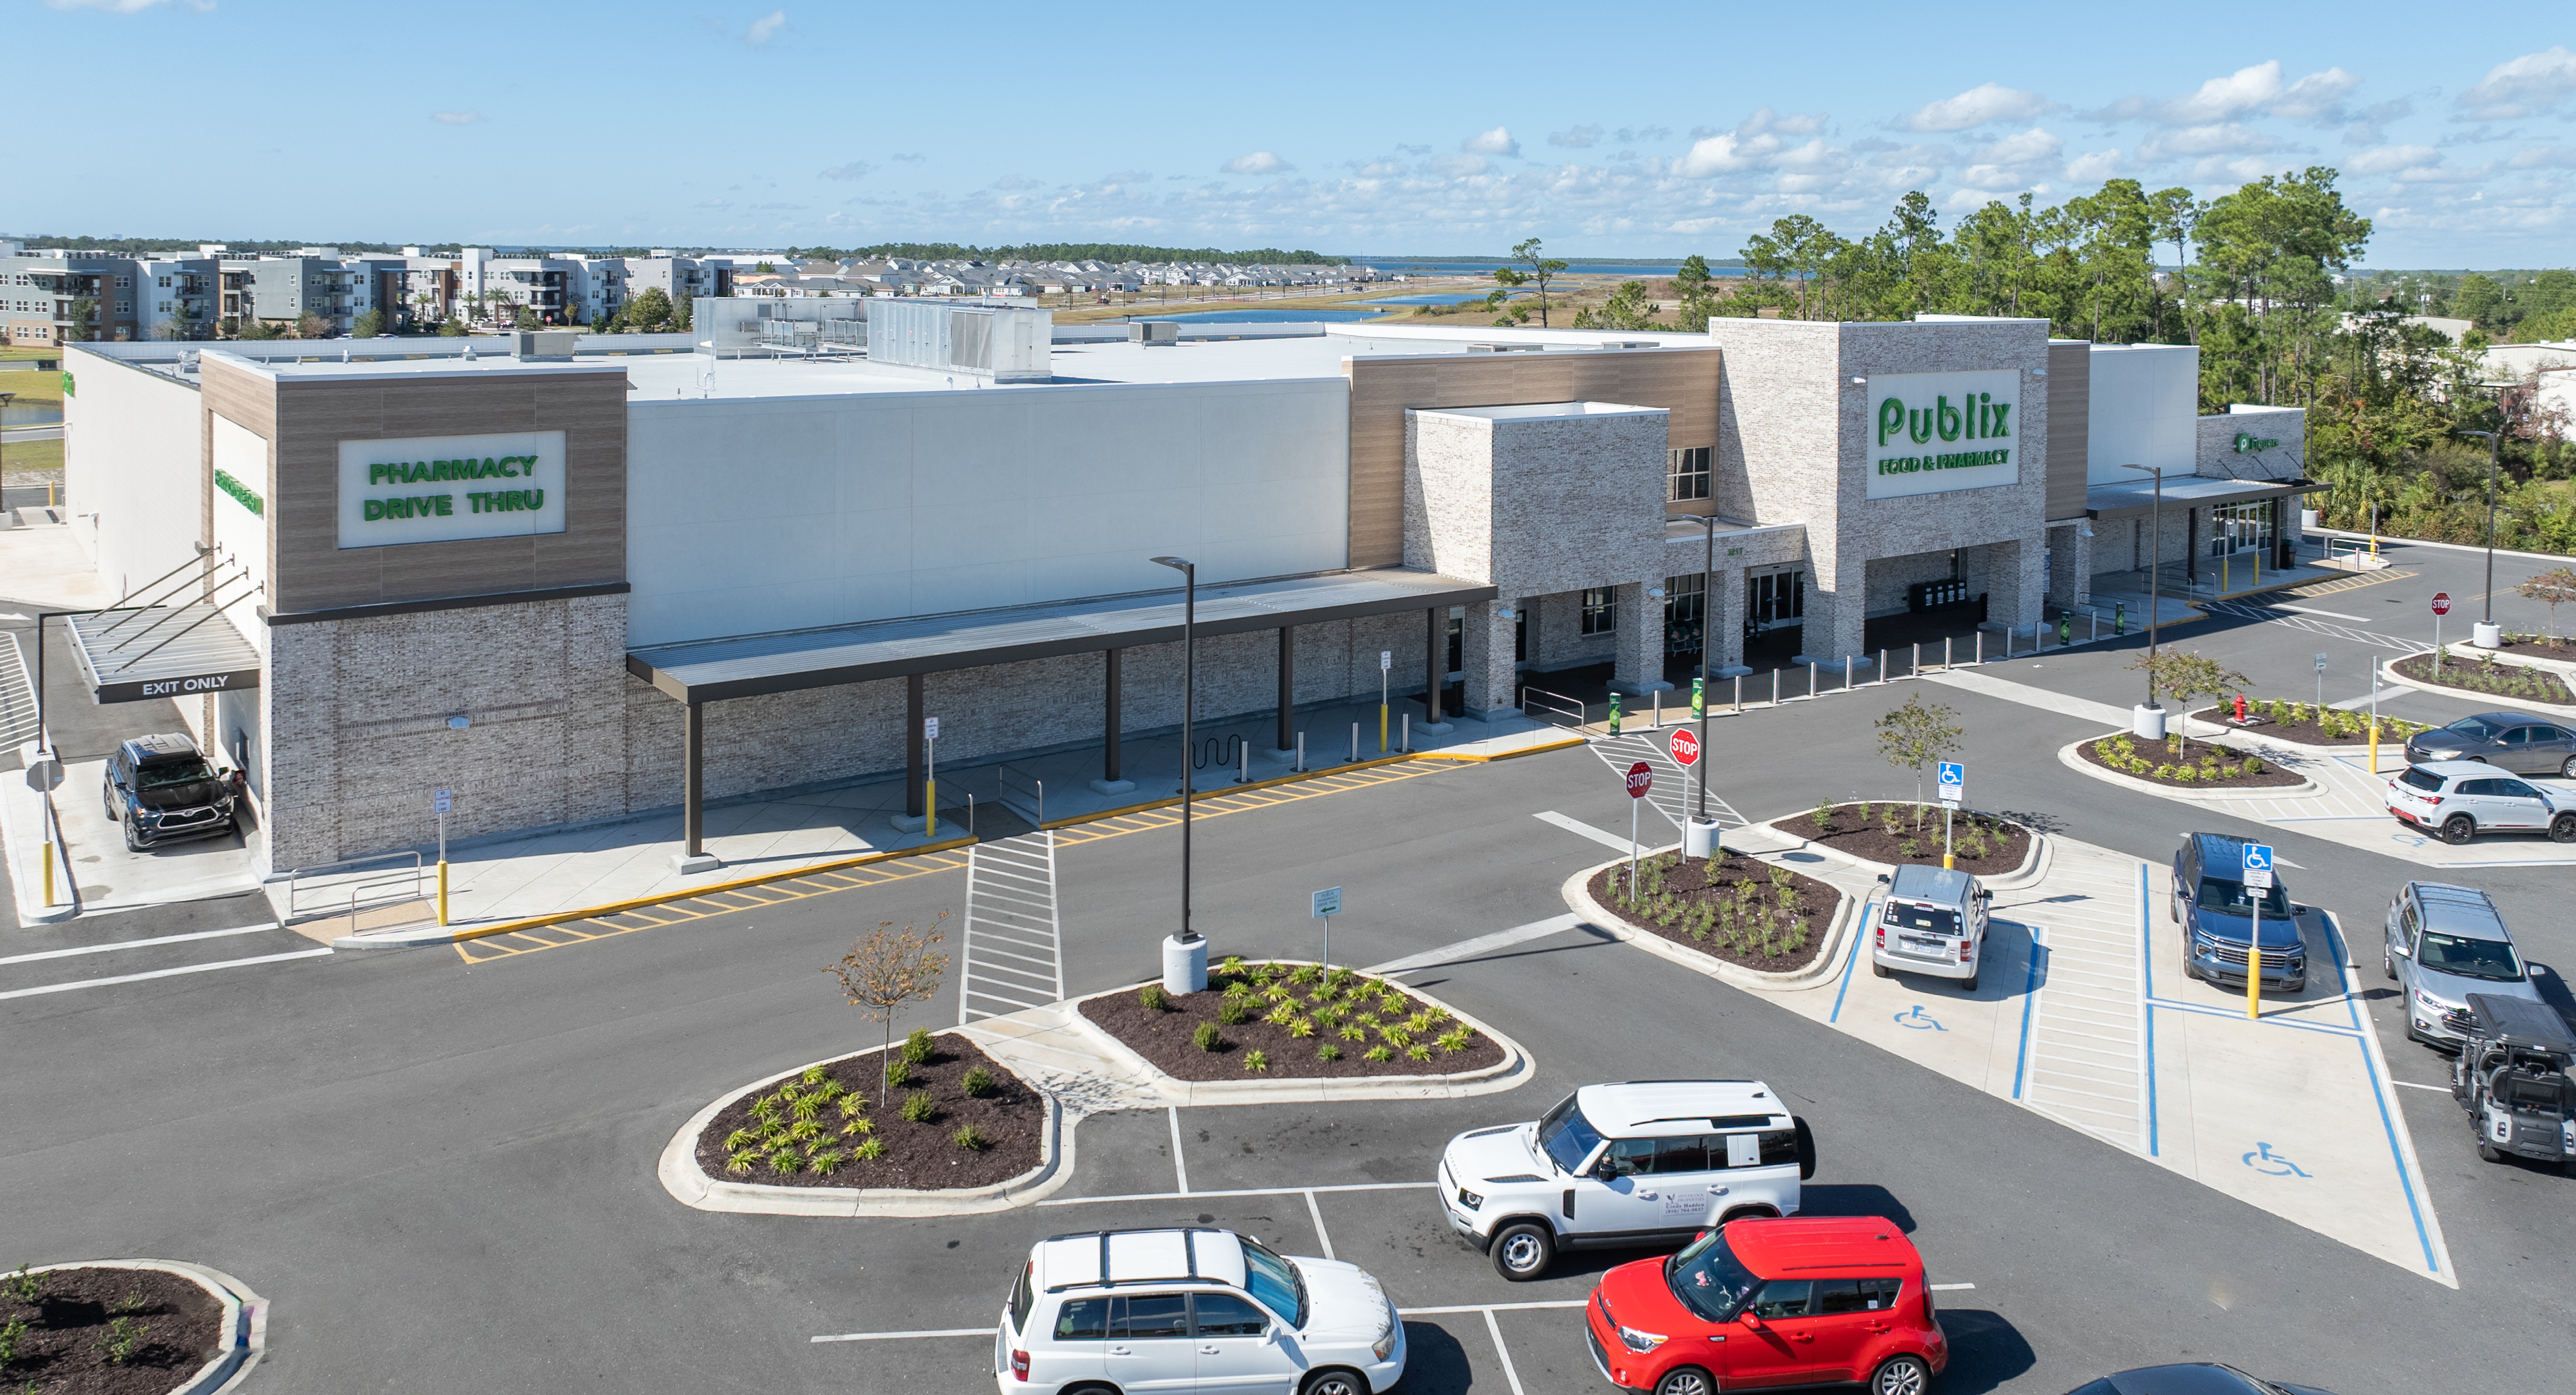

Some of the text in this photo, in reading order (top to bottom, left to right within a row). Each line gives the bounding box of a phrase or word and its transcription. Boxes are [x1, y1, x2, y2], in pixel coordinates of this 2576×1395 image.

[1879, 392, 2011, 446] Publix
[2250, 437, 2279, 452] Liquors
[370, 455, 538, 485] PHARMACY
[1879, 449, 2010, 475] FOOD & PHARMACY
[364, 489, 544, 521] DRIVE THRU
[2432, 599, 2450, 608] STOP
[143, 675, 228, 695] EXIT ONLY
[1672, 737, 1697, 756] STOP
[1627, 772, 1651, 788] STOP
